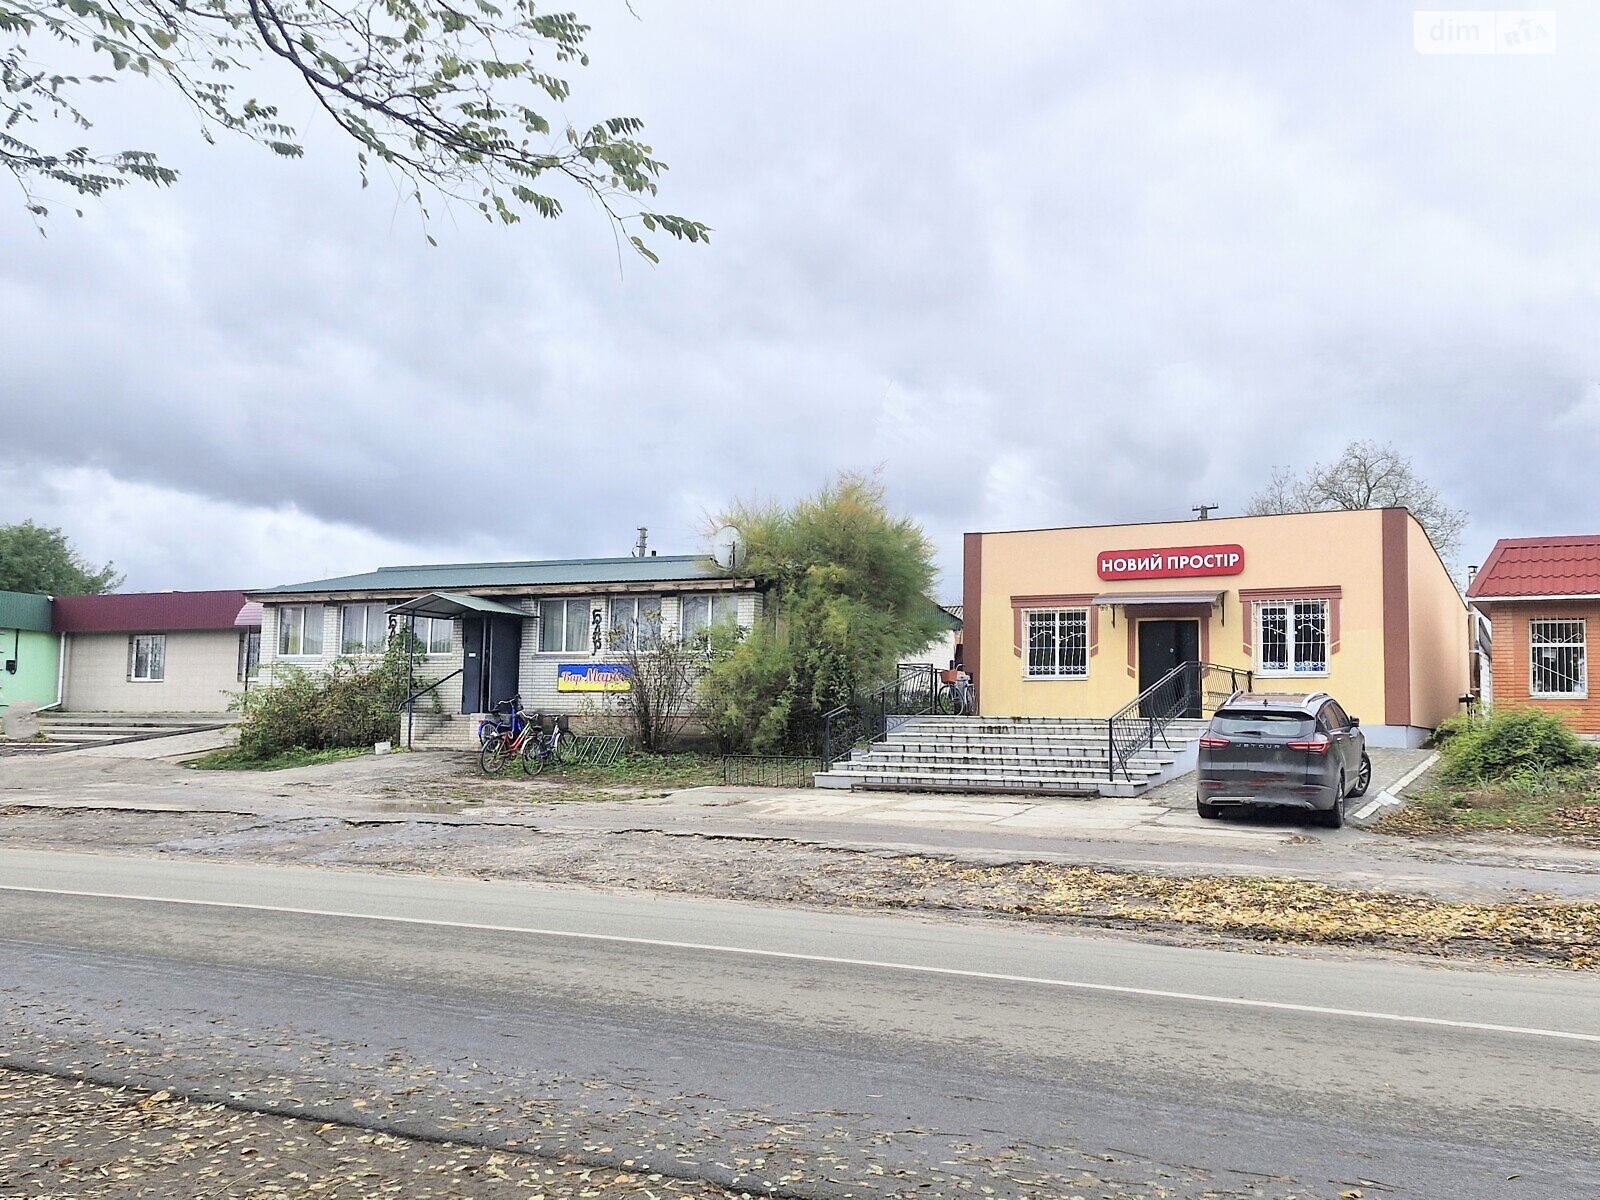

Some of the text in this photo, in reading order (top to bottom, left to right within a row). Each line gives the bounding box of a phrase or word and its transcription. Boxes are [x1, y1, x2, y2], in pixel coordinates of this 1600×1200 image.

[1101, 553, 1240, 573] НОВИЙ ПРОСТІР
[561, 671, 583, 686] Бар
